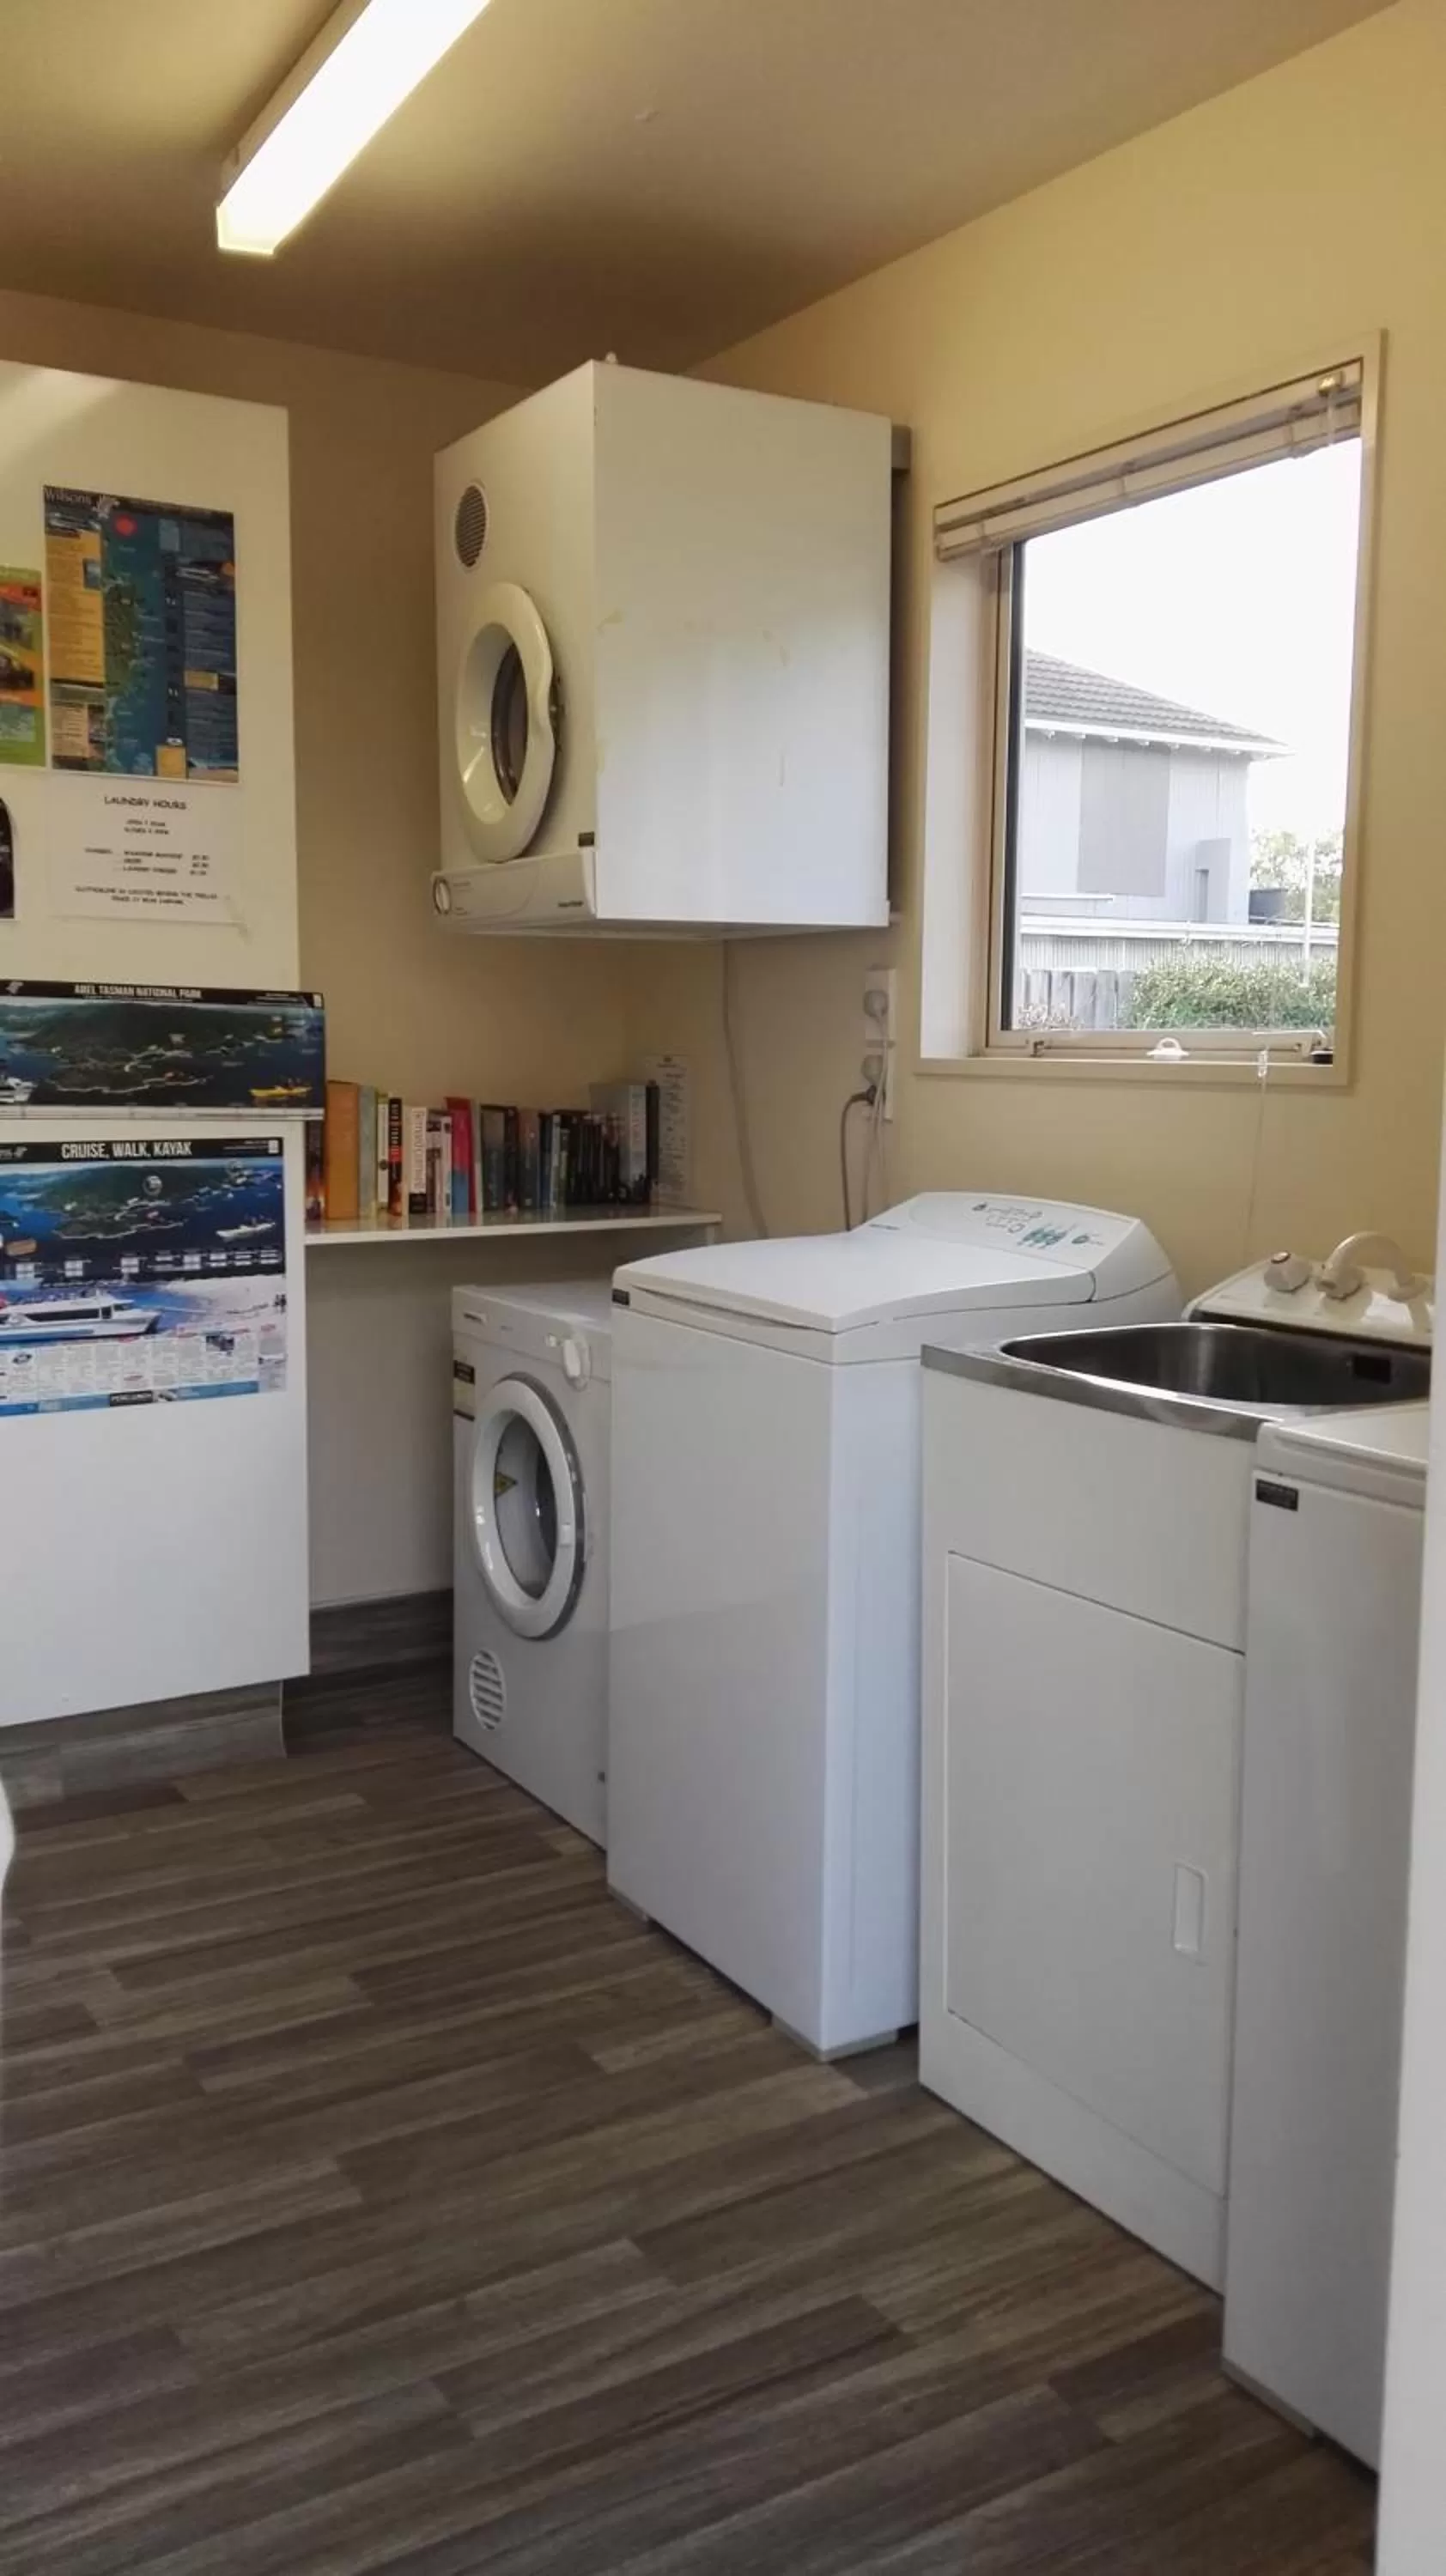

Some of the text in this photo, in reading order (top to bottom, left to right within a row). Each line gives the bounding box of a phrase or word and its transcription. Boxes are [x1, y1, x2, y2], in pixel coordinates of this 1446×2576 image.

[104, 796, 186, 810] LAUNDRY HOURS
[75, 984, 96, 995] ABEL
[99, 985, 135, 996] TASMAN
[136, 987, 178, 999] NATIONAL
[179, 989, 202, 999] PARK
[154, 1141, 192, 1157] KAYAK
